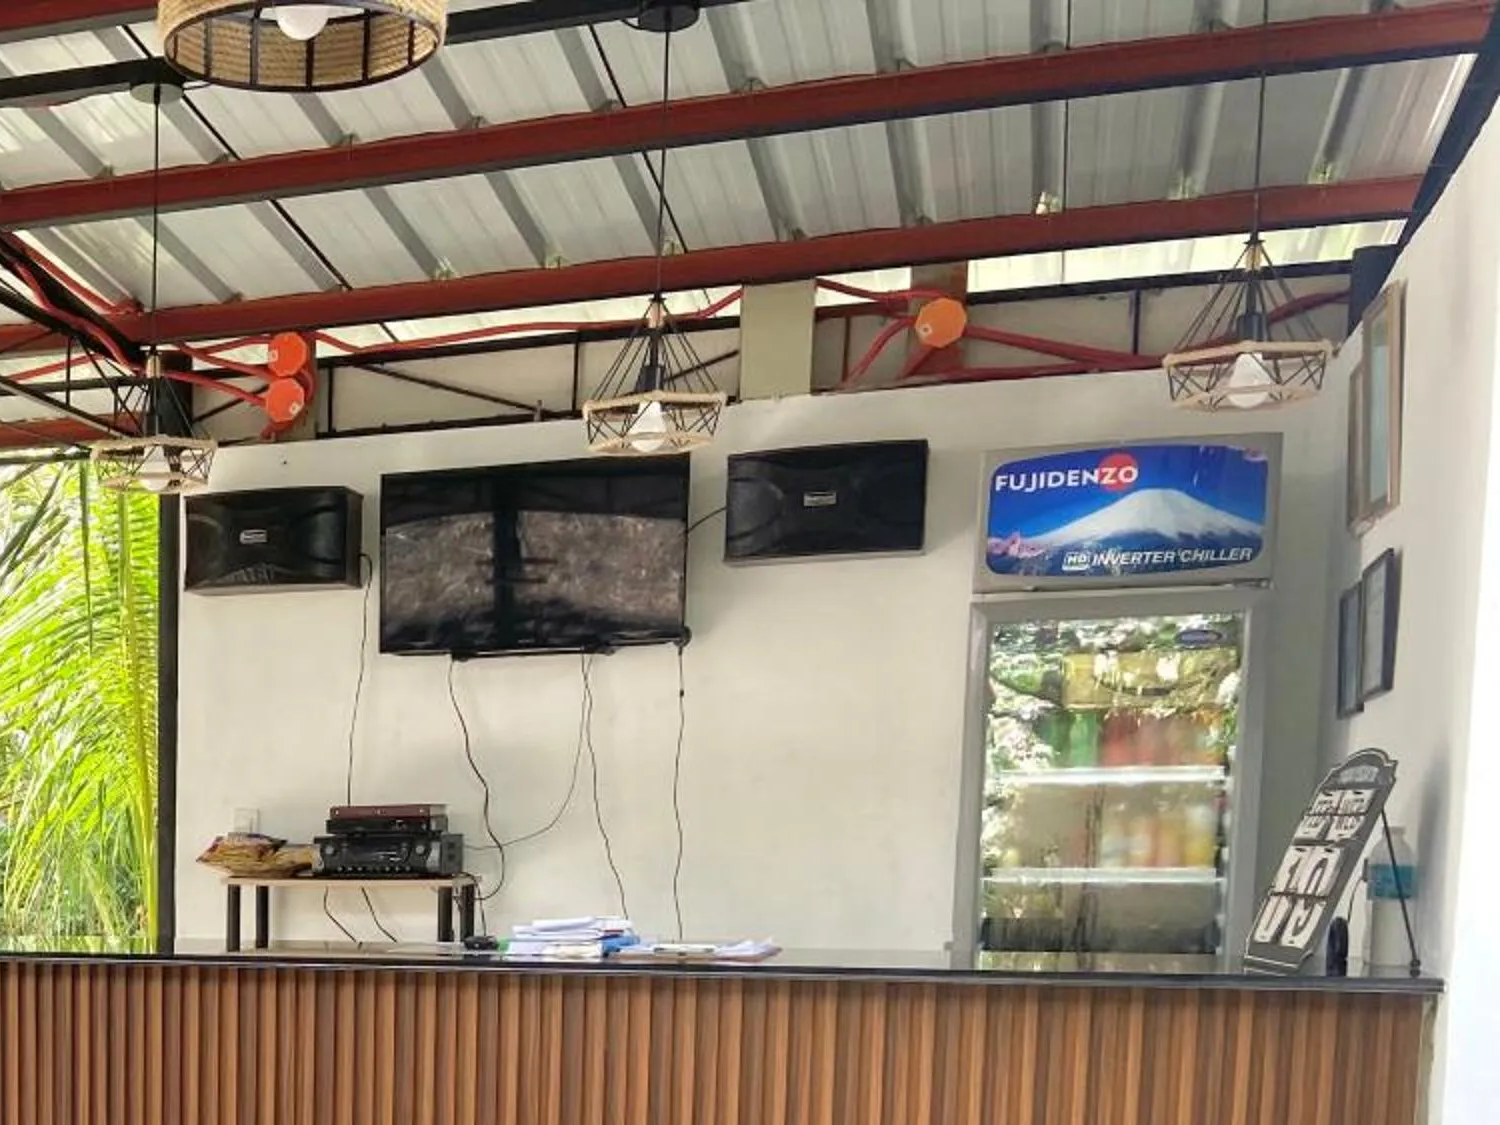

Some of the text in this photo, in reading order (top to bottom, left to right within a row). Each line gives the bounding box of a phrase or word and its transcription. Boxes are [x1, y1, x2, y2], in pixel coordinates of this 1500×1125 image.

[995, 465, 1138, 491] FUJIDENZO
[1092, 550, 1174, 566] INVERTER
[1180, 547, 1252, 562] CHILLER
